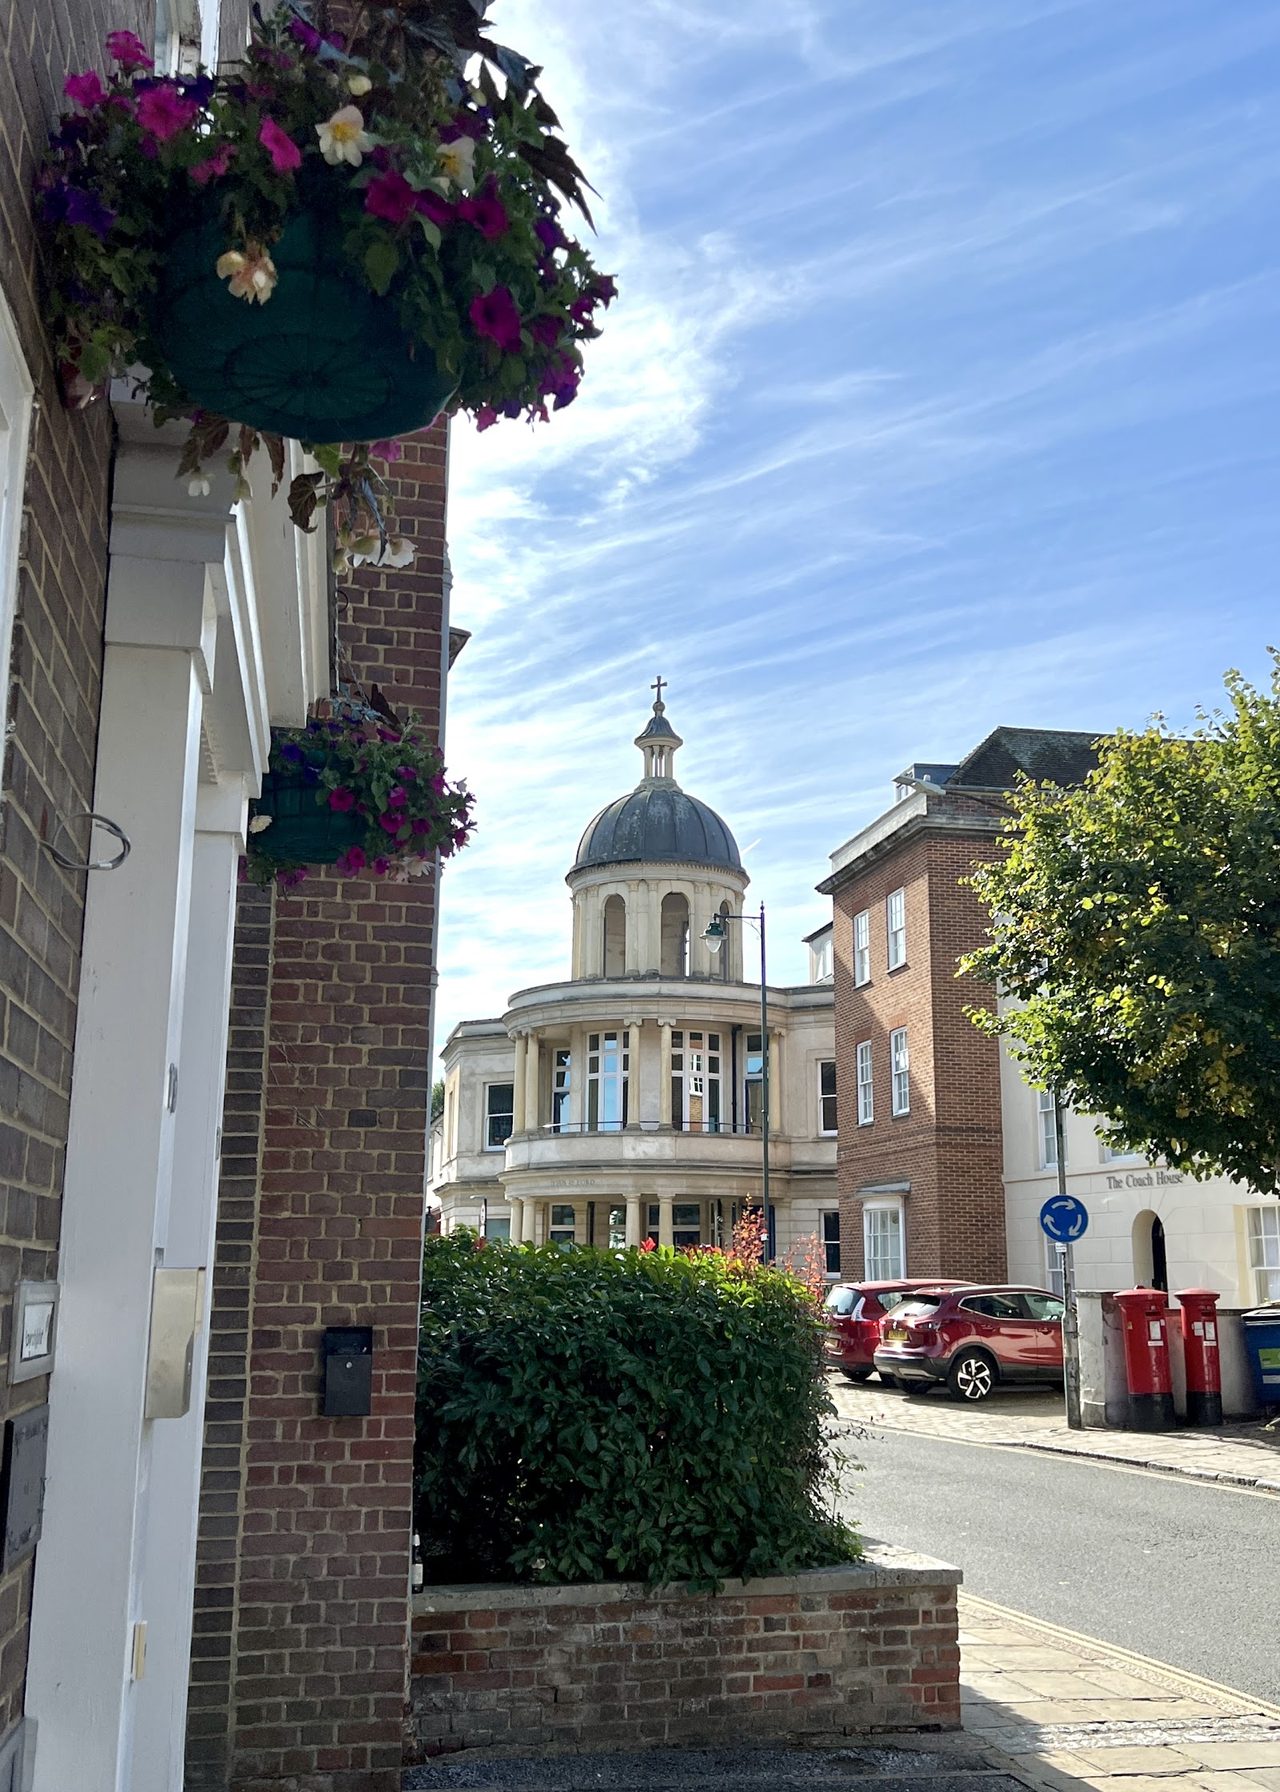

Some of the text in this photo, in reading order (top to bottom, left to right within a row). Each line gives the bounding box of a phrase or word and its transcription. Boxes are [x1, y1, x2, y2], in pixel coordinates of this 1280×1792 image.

[1106, 1171, 1183, 1189] The Coach House
